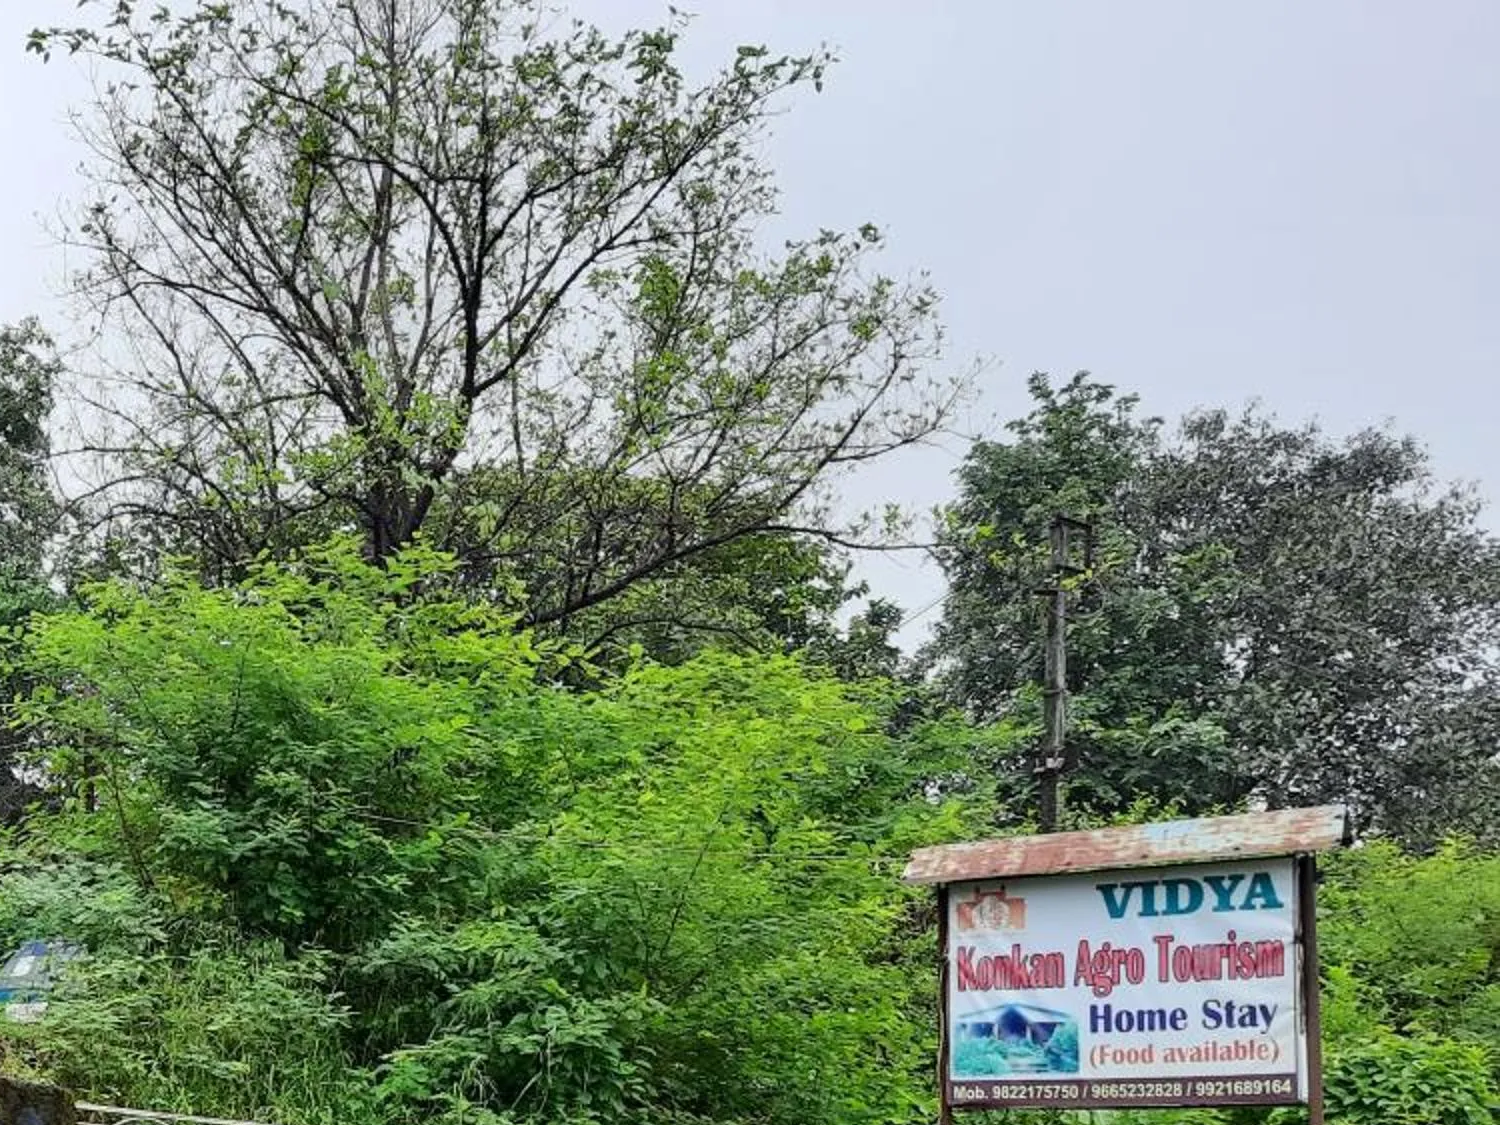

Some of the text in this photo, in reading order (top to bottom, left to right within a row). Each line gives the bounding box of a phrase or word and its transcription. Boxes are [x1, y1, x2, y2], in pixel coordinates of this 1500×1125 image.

[1096, 872, 1283, 919] VIDYA
[957, 930, 1285, 997] Konkan Agro Tourism
[1090, 999, 1278, 1036] Home Stay
[1090, 1038, 1280, 1069] (Food available)
[953, 1084, 989, 1101] Mob.
[992, 1083, 1079, 1100] 9822175750
[1195, 1079, 1292, 1097] 9921689164
